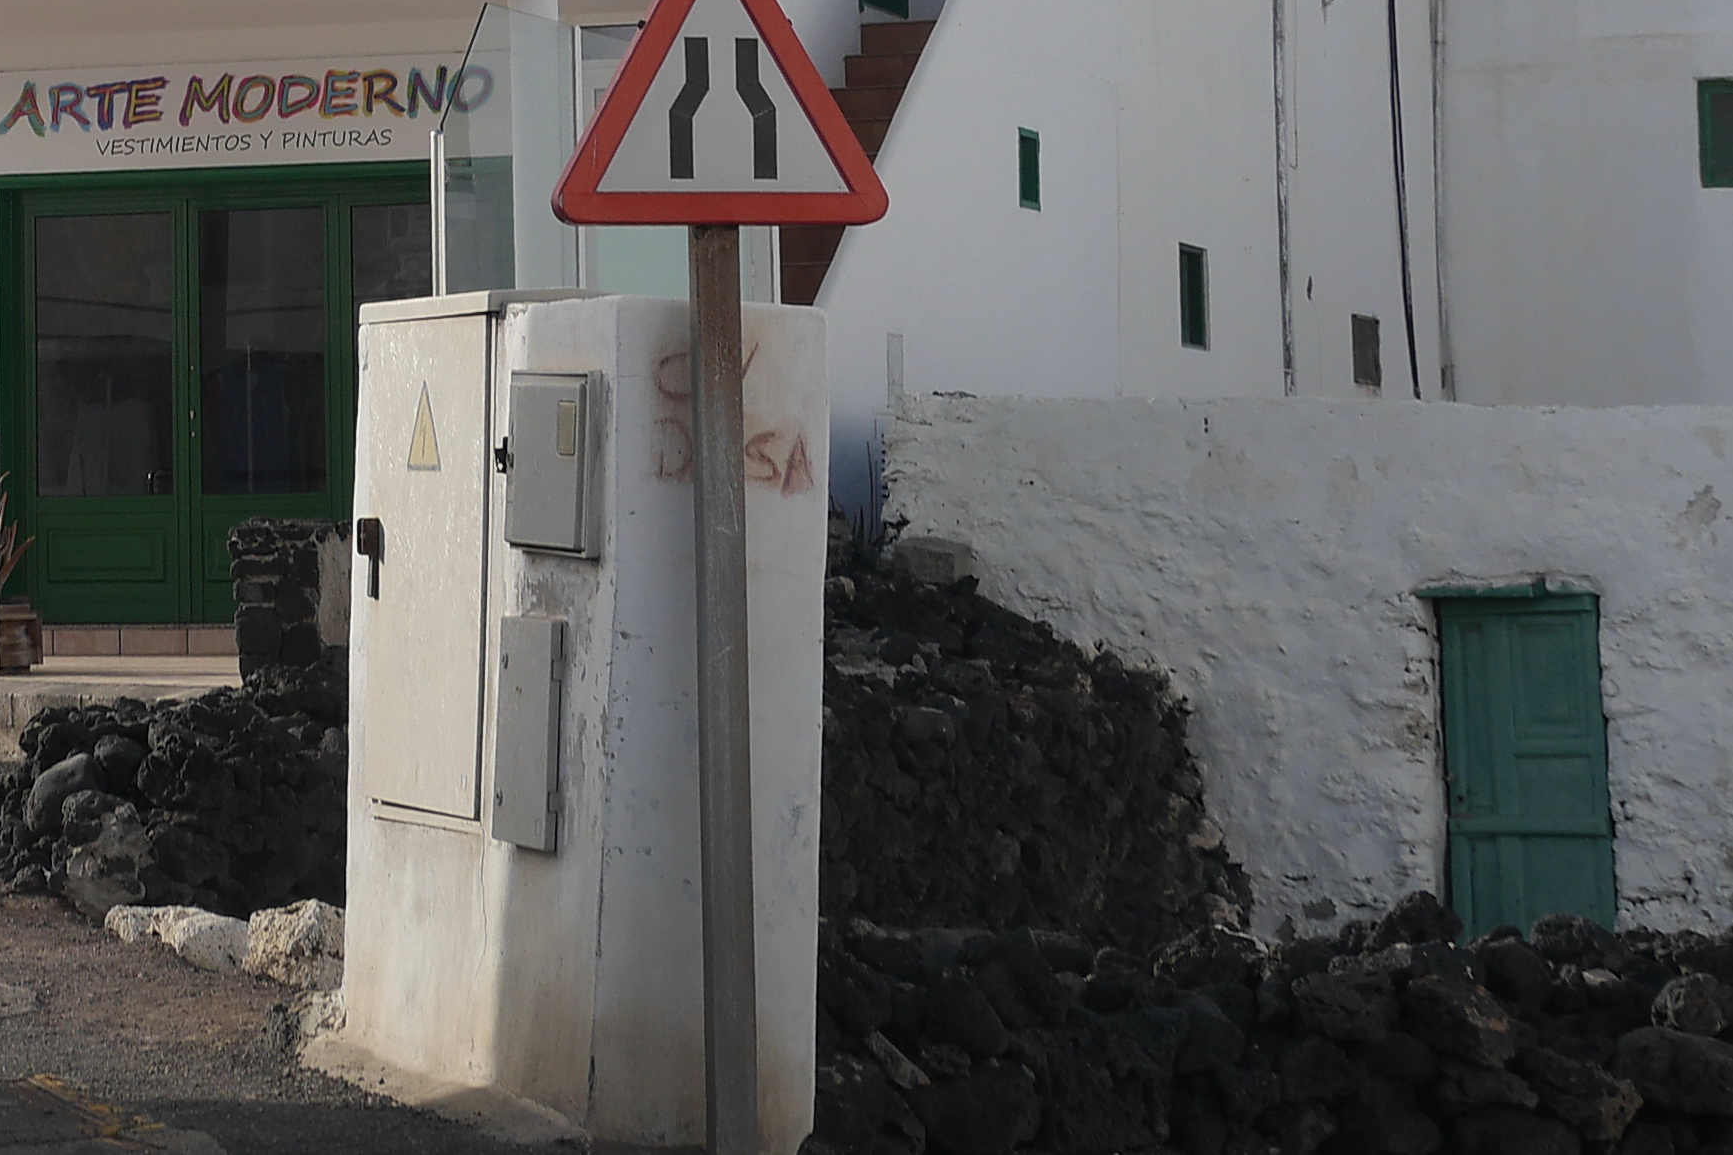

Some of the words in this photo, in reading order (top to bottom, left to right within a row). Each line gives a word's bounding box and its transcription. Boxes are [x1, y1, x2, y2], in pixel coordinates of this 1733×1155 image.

[179, 64, 495, 127] MODERNO
[95, 132, 251, 156] VESTIMIENTOS
[259, 131, 272, 150] Y
[281, 128, 393, 150] PINTURAS
